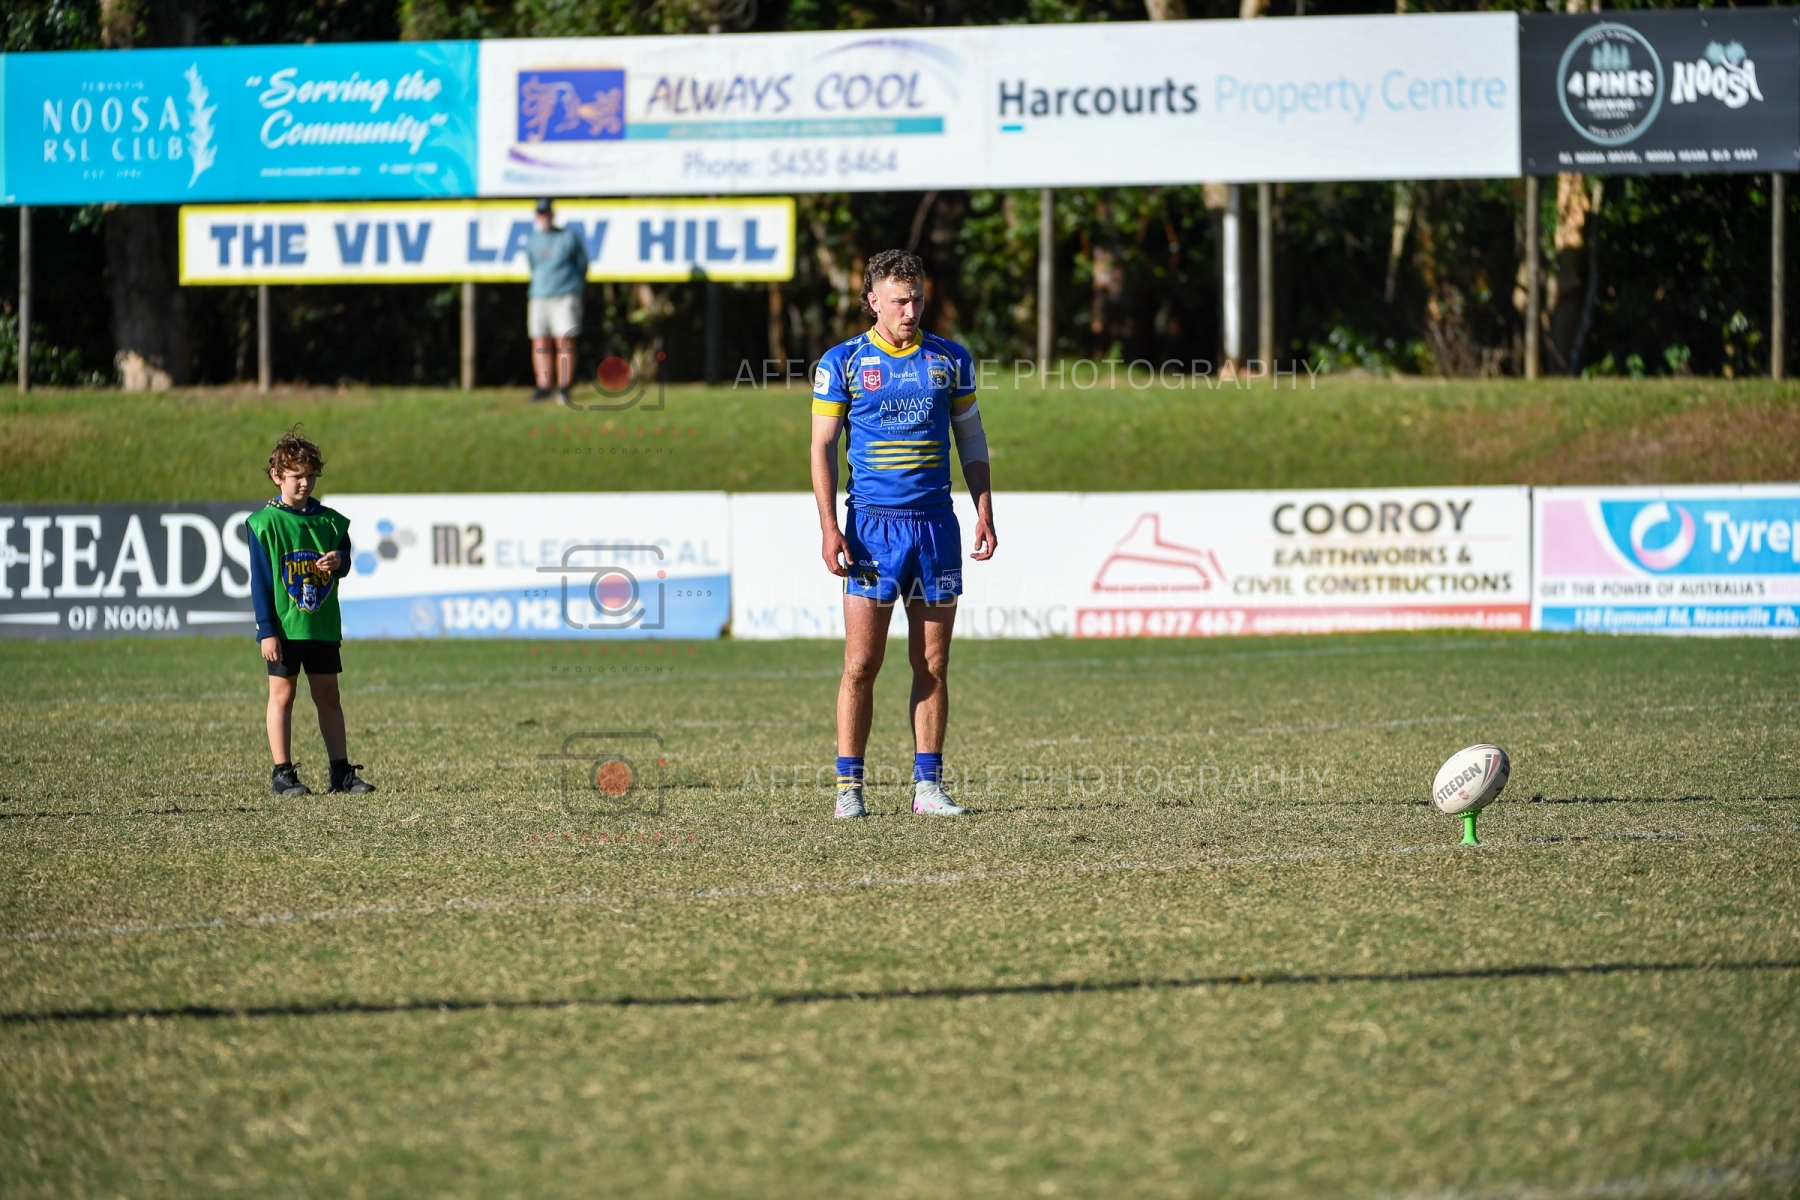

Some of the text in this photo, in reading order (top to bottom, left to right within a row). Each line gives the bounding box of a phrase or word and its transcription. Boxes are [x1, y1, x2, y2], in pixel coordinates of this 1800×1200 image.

[393, 69, 442, 102] the
[645, 72, 927, 114] ALWAYS COOL
[999, 70, 1507, 123] Harcourts Property Centre
[1567, 69, 1654, 98] 4 PINES
[1670, 59, 1764, 109] NOOSA
[43, 96, 181, 134] NOOSA
[44, 136, 184, 162] RSL CLUB
[210, 218, 779, 266] THE VIV LAW HILL
[880, 397, 934, 412] ALWAYS
[898, 411, 933, 423] COOL
[1272, 500, 1473, 535] COOROY
[432, 523, 722, 570] M2 ELECTRICAL
[1274, 545, 1472, 568] EARTHWORKS &
[1232, 571, 1513, 596] CIVIL CONSTRUCTIONS
[1571, 582, 1595, 597] THE
[1602, 581, 1652, 596] POWER
[1657, 580, 1673, 596] OF
[1680, 580, 1765, 595] AUSTRALIA'S
[68, 605, 181, 631] OF NOOSA
[440, 598, 514, 630] 1300
[518, 598, 560, 630] M2
[1436, 762, 1482, 804] STEEDEN
